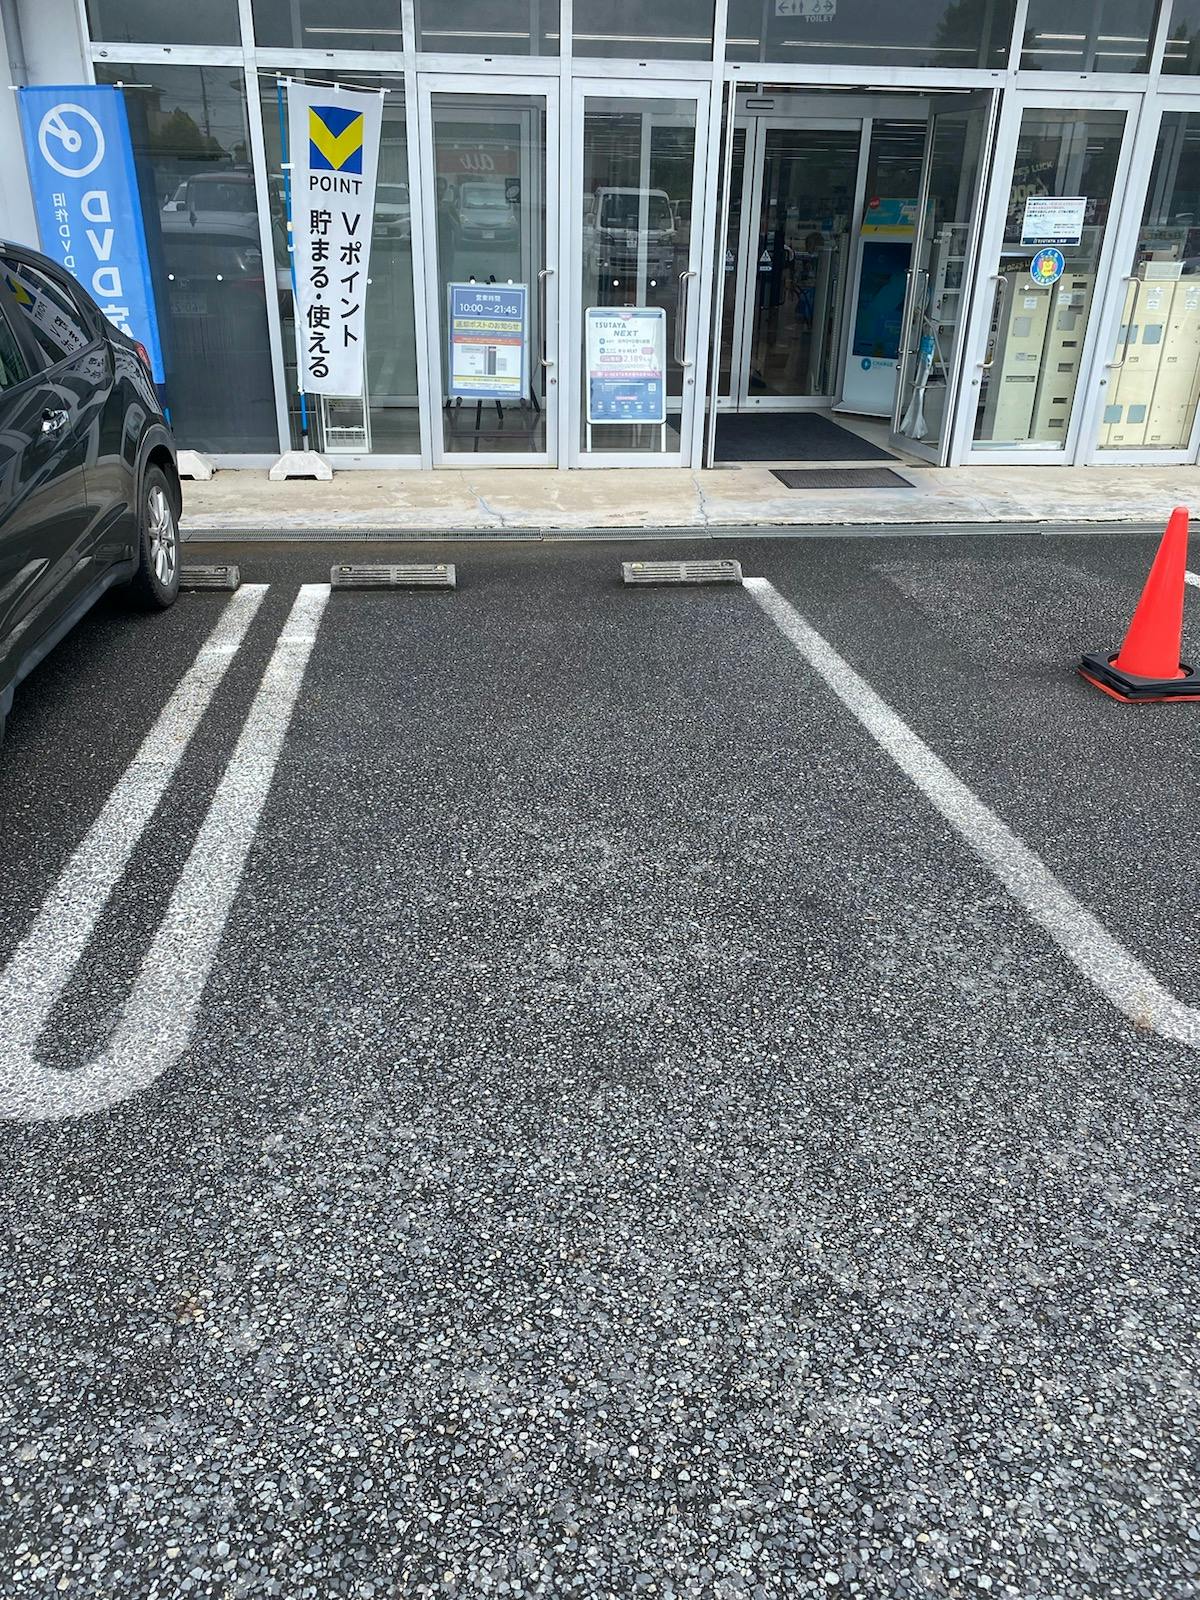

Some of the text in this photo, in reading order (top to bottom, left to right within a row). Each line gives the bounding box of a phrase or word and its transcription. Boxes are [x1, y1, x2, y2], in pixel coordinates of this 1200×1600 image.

[805, 15, 834, 23] TOILET
[309, 175, 363, 195] POINT
[306, 209, 332, 378] 貯まる・使える
[340, 211, 362, 348] Vポイント
